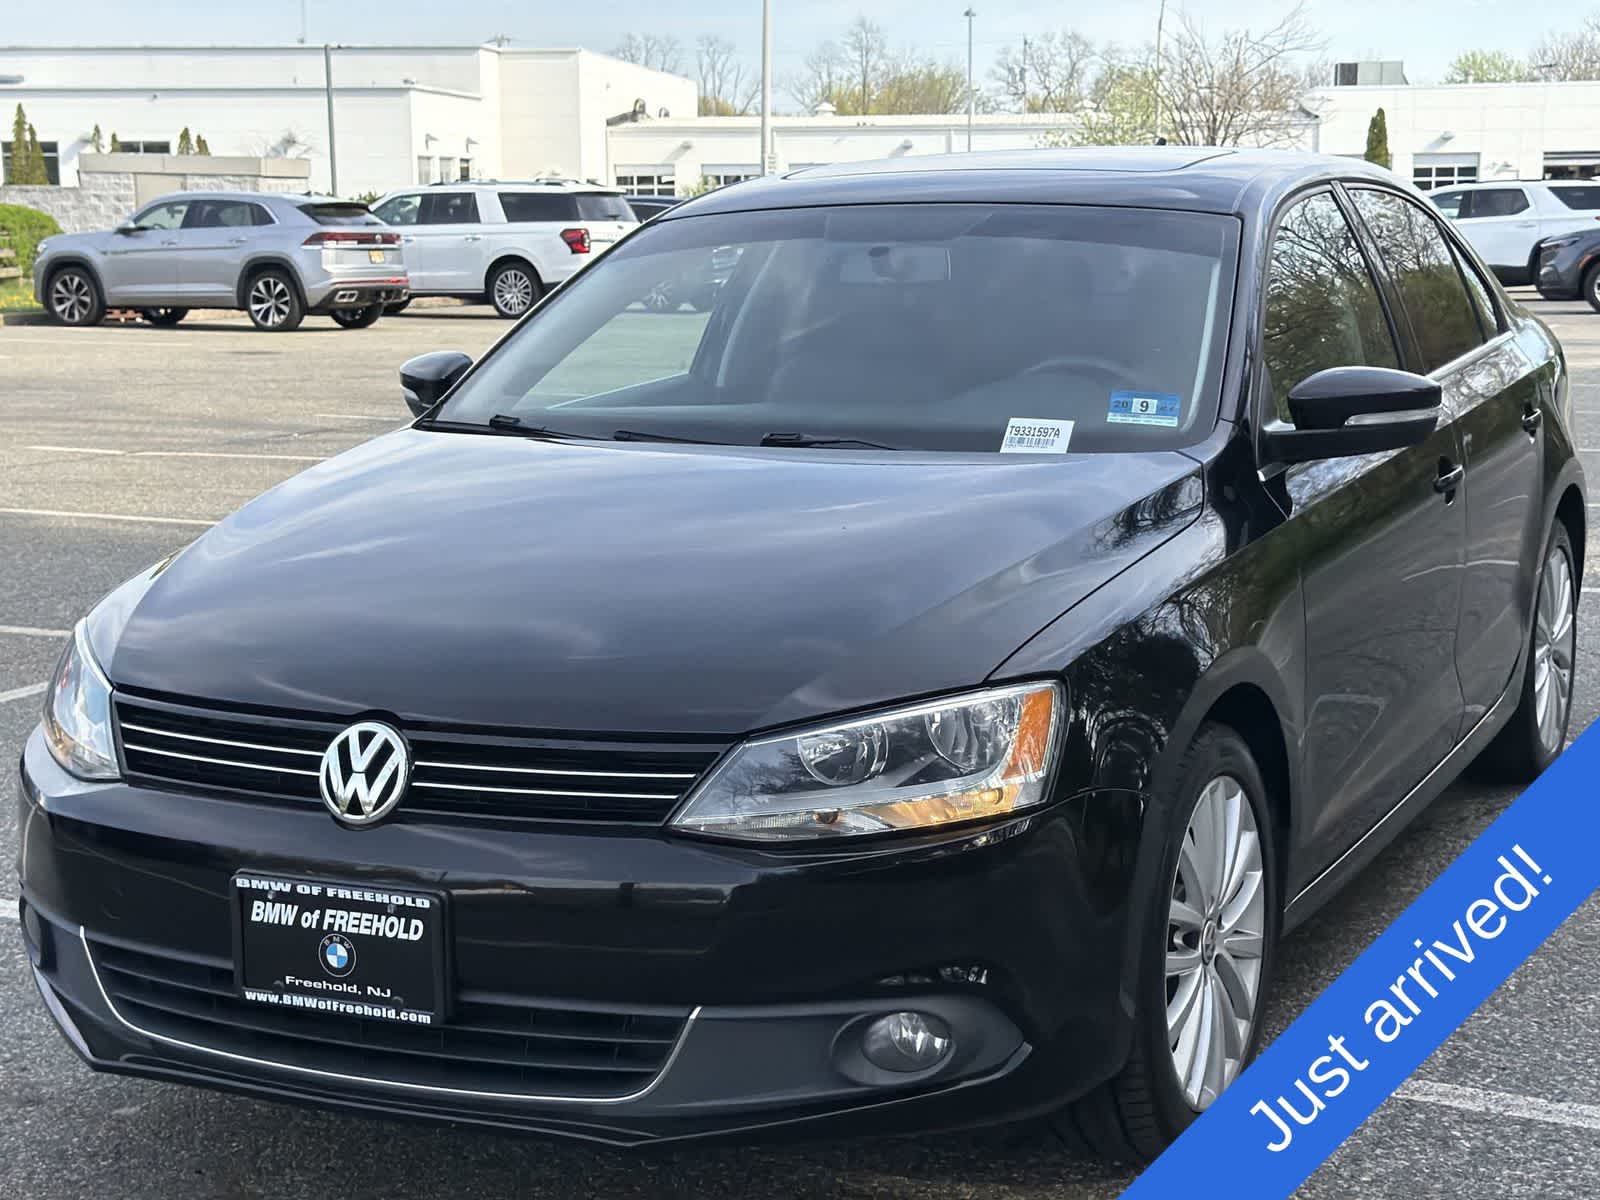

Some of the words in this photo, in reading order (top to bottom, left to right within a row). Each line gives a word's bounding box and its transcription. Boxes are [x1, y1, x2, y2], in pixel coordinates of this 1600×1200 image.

[1140, 400, 1149, 413] 9
[1009, 425, 1061, 439] T9331597A
[236, 878, 291, 892] BMW
[296, 884, 322, 896] OF
[326, 887, 430, 908] FREEHOLD
[250, 900, 299, 926] BMW
[301, 909, 319, 929] of
[322, 909, 424, 941] FREEHOLD
[285, 975, 362, 995] Freehold,
[367, 986, 391, 998] NJ
[245, 991, 431, 1024] www.BMWofFreehold.com
